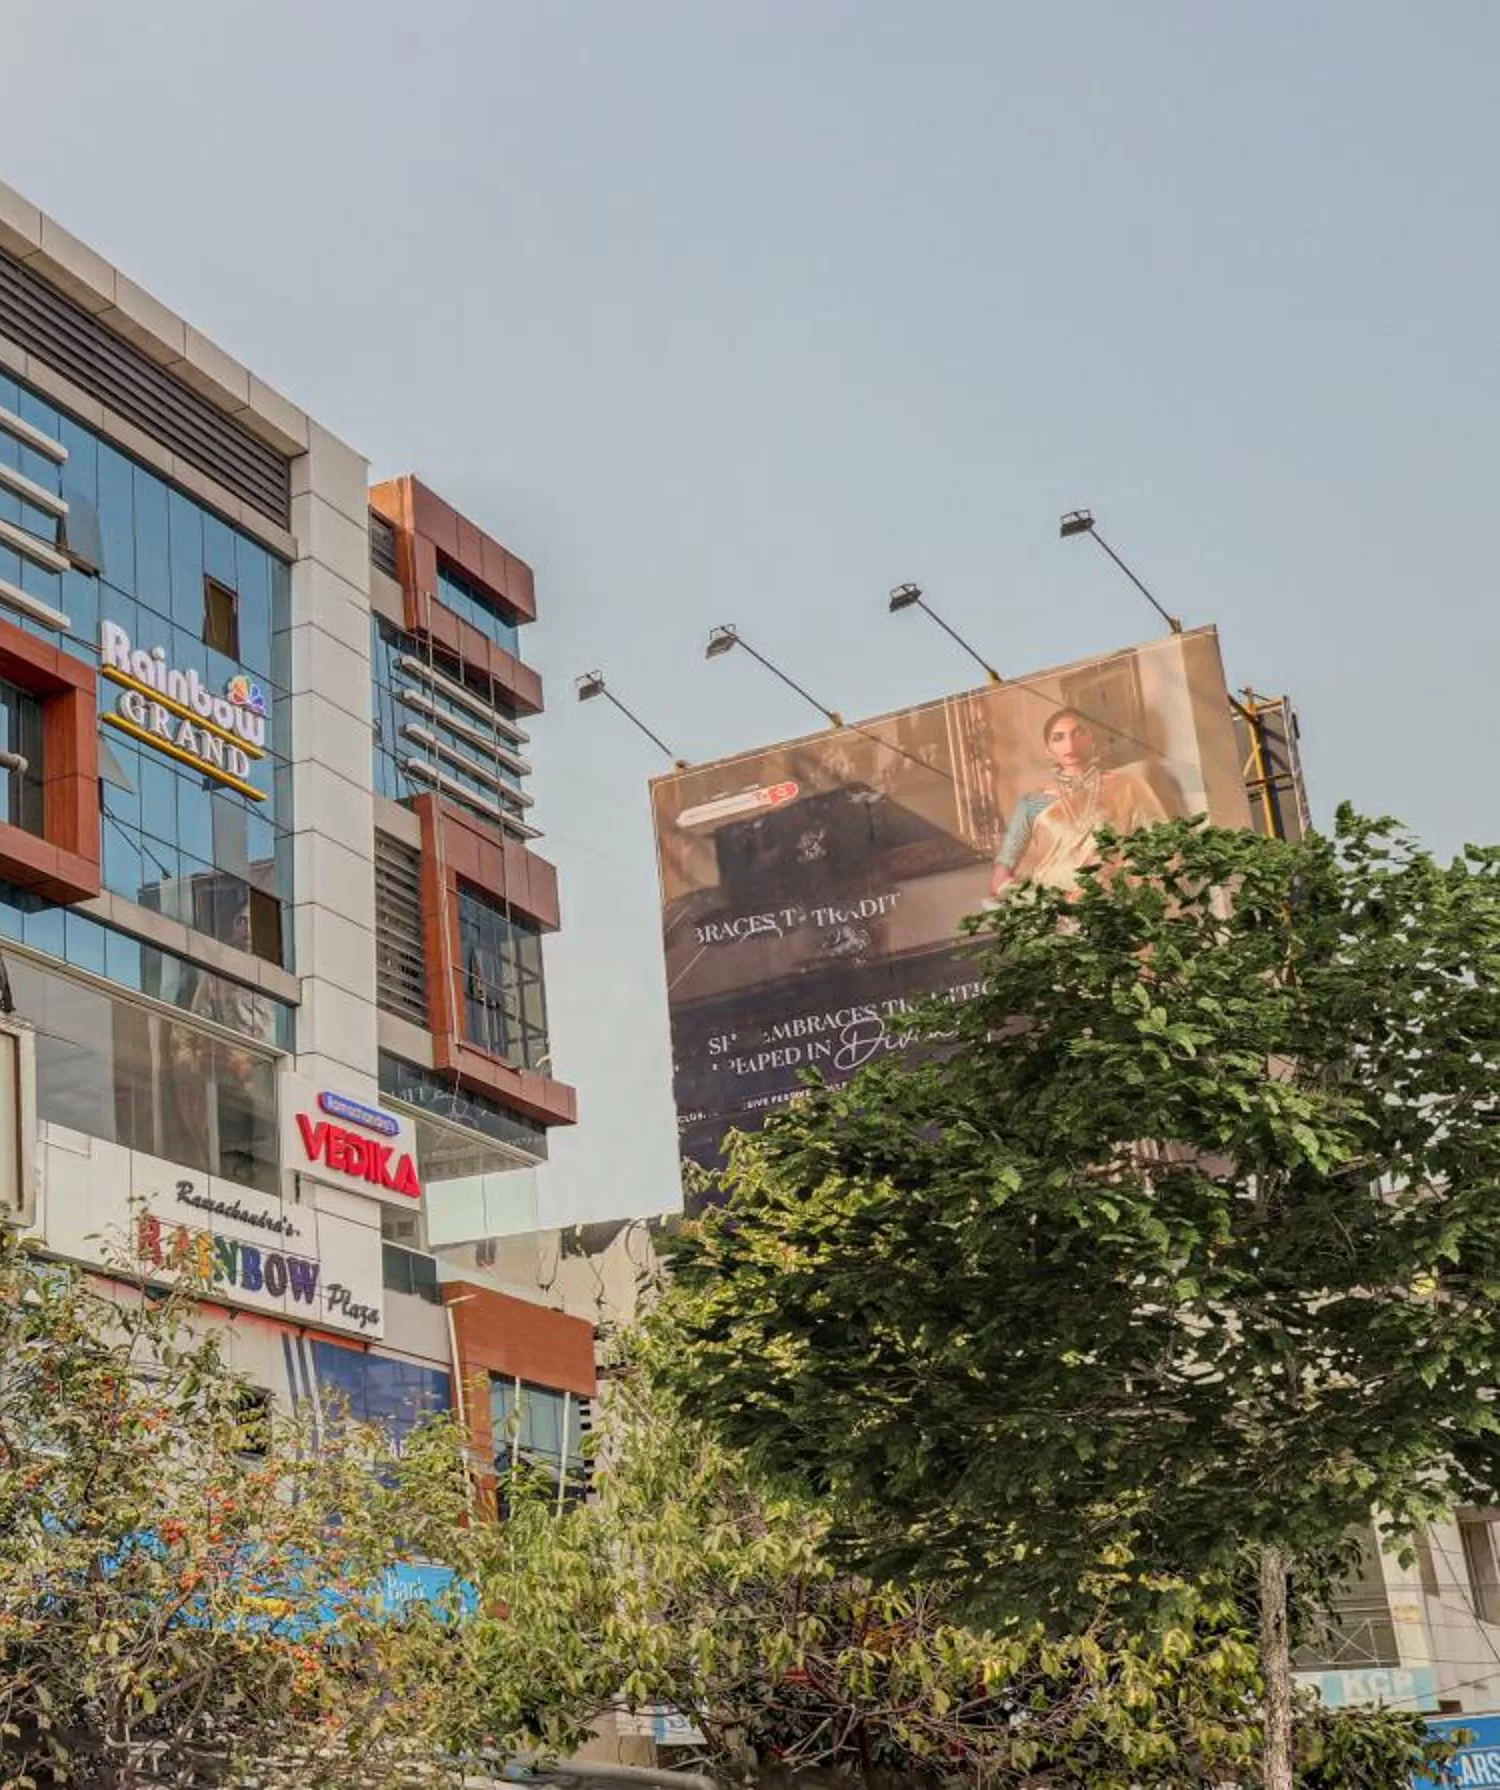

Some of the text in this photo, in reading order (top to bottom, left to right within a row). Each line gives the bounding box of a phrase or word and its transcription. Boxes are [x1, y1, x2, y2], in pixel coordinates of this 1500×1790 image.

[101, 620, 265, 746] Rainbow
[119, 689, 250, 779] GRAND
[295, 1112, 420, 1198] VEDIKA
[327, 1283, 380, 1329] Plaza
